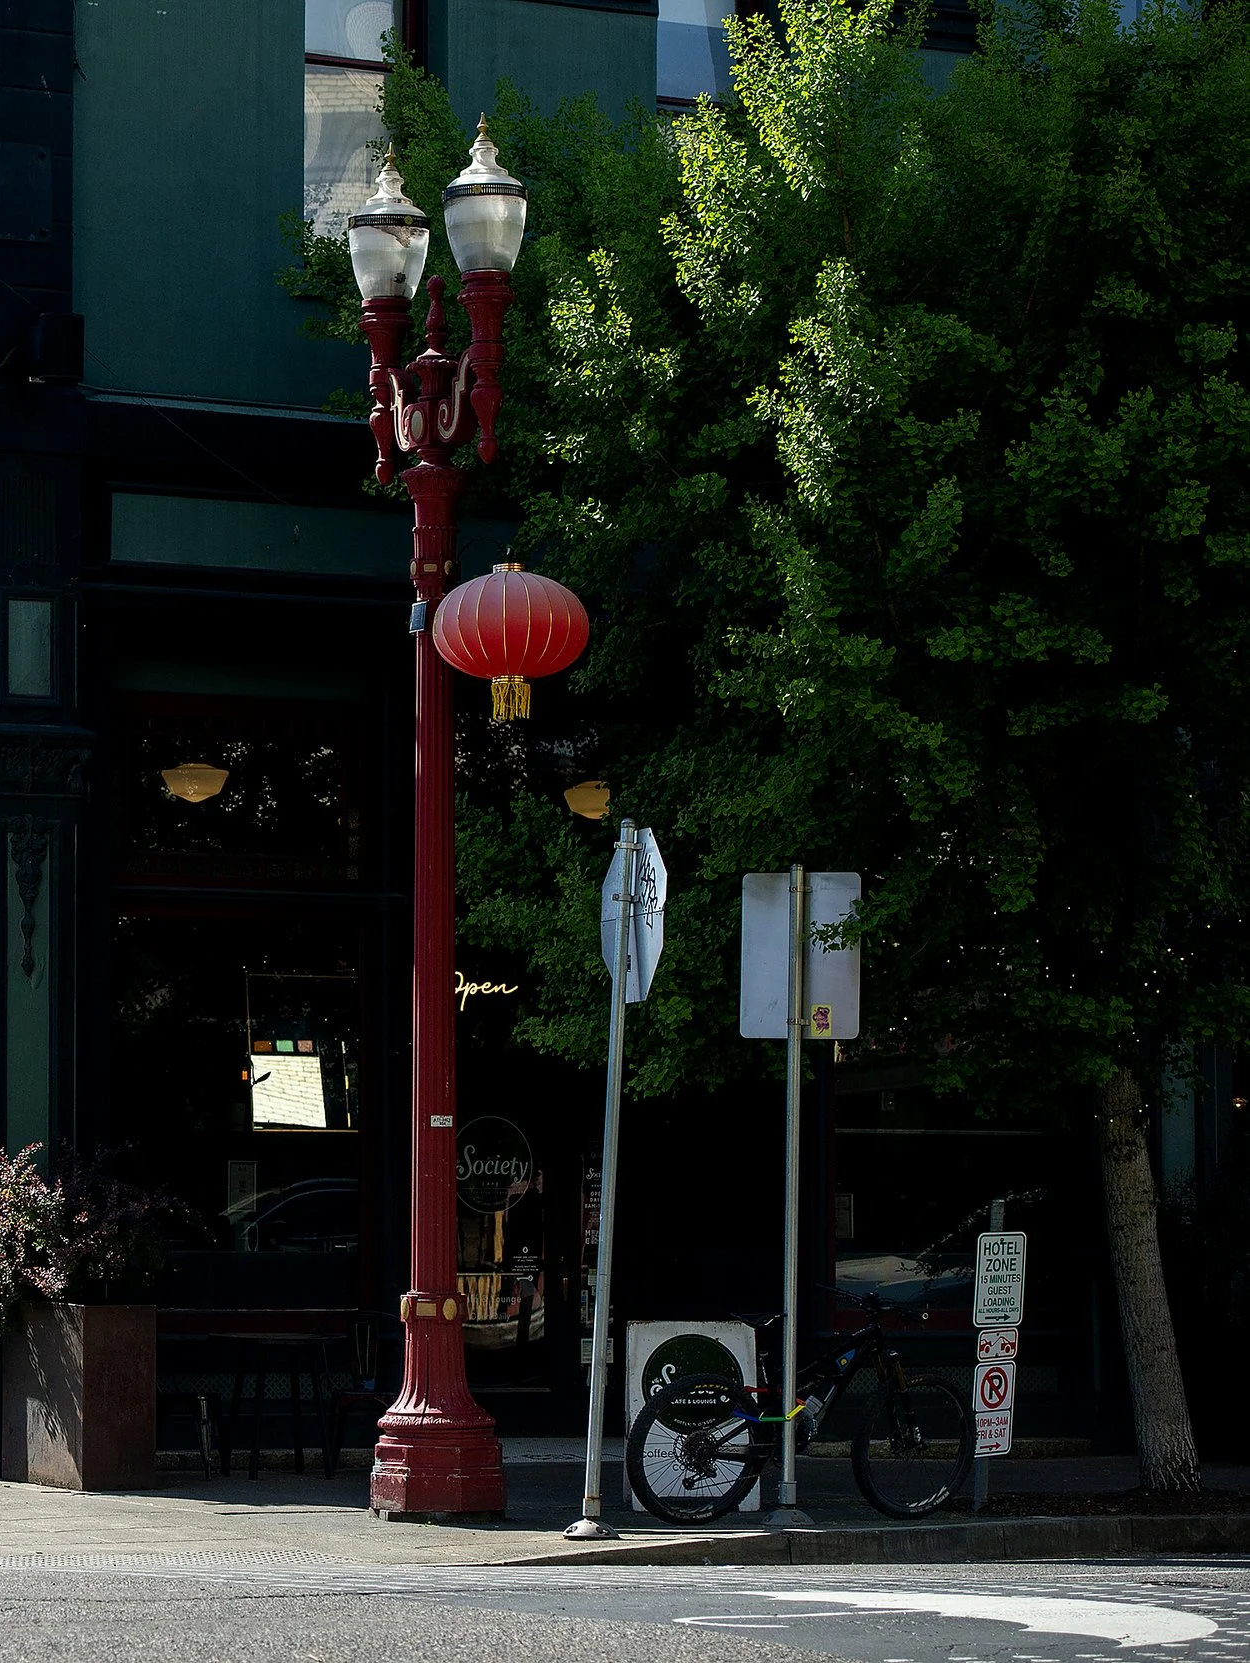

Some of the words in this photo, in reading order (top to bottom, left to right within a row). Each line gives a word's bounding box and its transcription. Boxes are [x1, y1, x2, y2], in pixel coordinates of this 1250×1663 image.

[456, 1145, 528, 1184] Society
[983, 1241, 1020, 1256] HOTEL
[985, 1258, 1017, 1272] ZONE
[980, 1275, 988, 1284] 15
[989, 1273, 1021, 1284] MINUTES
[987, 1285, 1012, 1296] GUEST
[983, 1297, 1015, 1307] LOADING
[976, 1416, 1009, 1428] 10PM-3AM
[976, 1429, 987, 1440] FRI
[988, 1429, 993, 1439] &
[994, 1427, 1006, 1439] SAT
